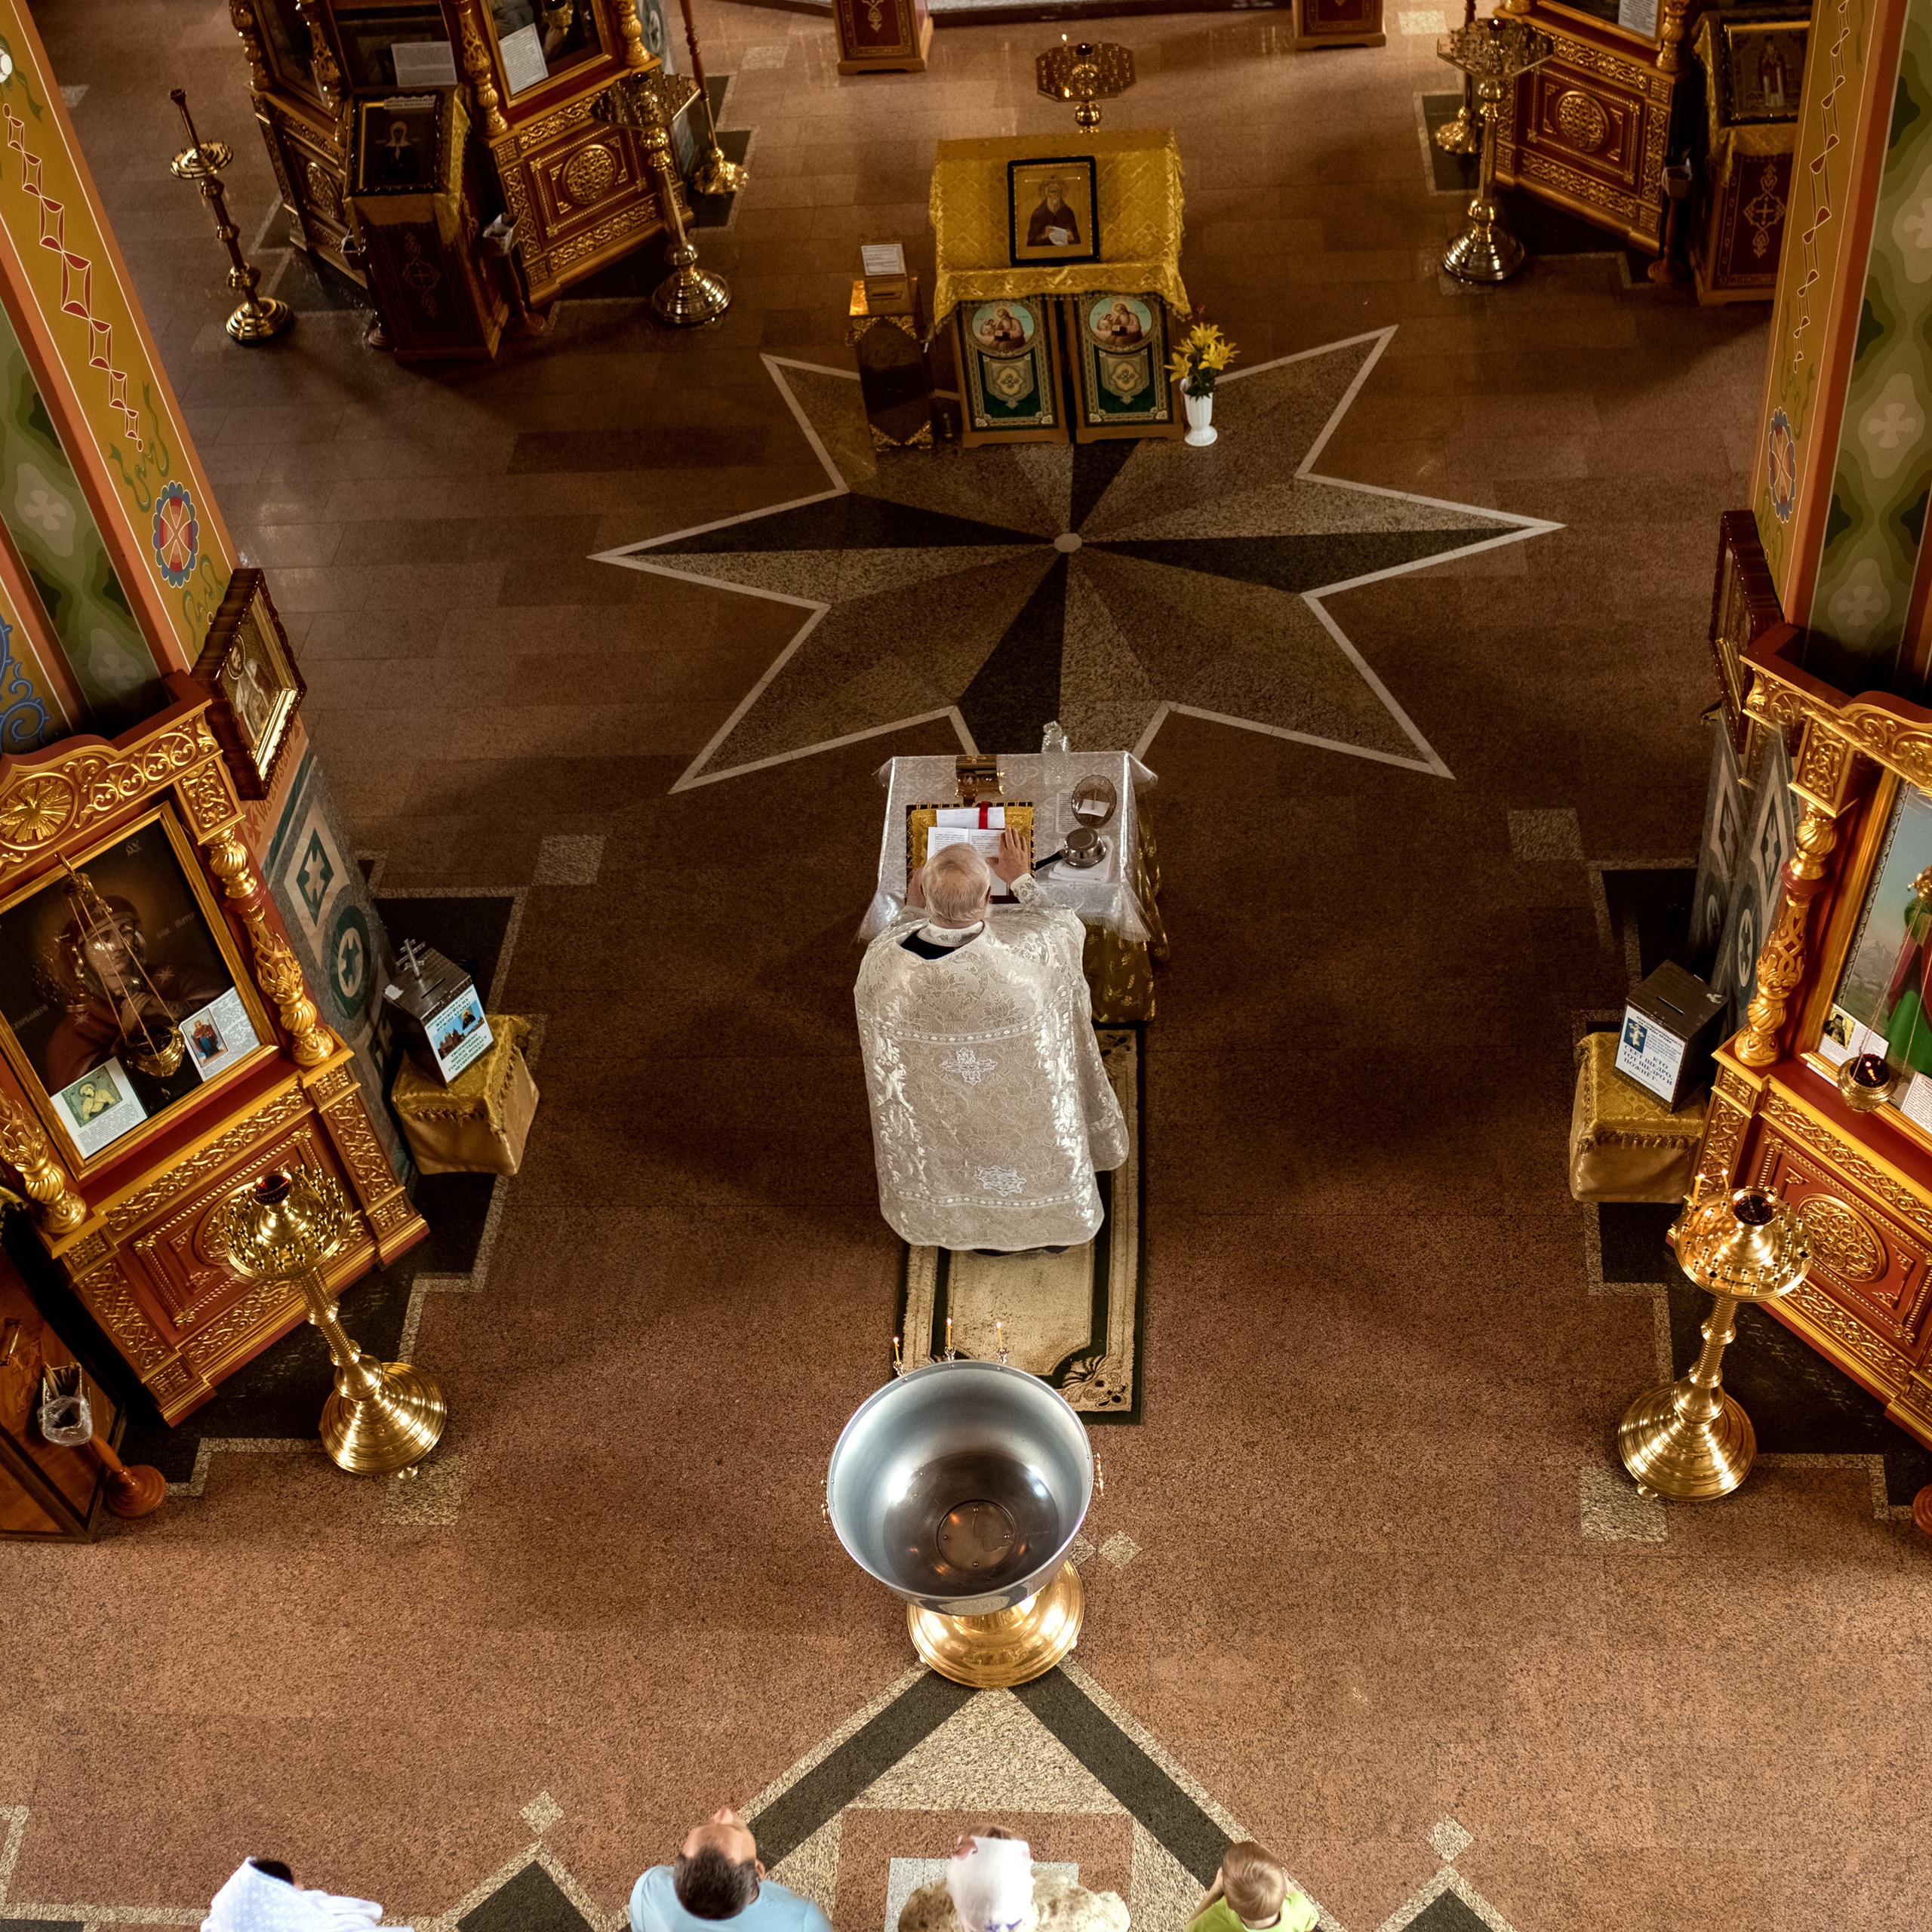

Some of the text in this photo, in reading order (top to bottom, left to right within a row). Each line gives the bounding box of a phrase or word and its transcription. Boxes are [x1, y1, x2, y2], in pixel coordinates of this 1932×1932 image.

[1624, 1045, 1642, 1059] СЕЕТ
[1623, 1050, 1636, 1062] ТОТ
[1638, 1061, 1665, 1081] ЩЕДРО
[1653, 1057, 1668, 1069] КТО
